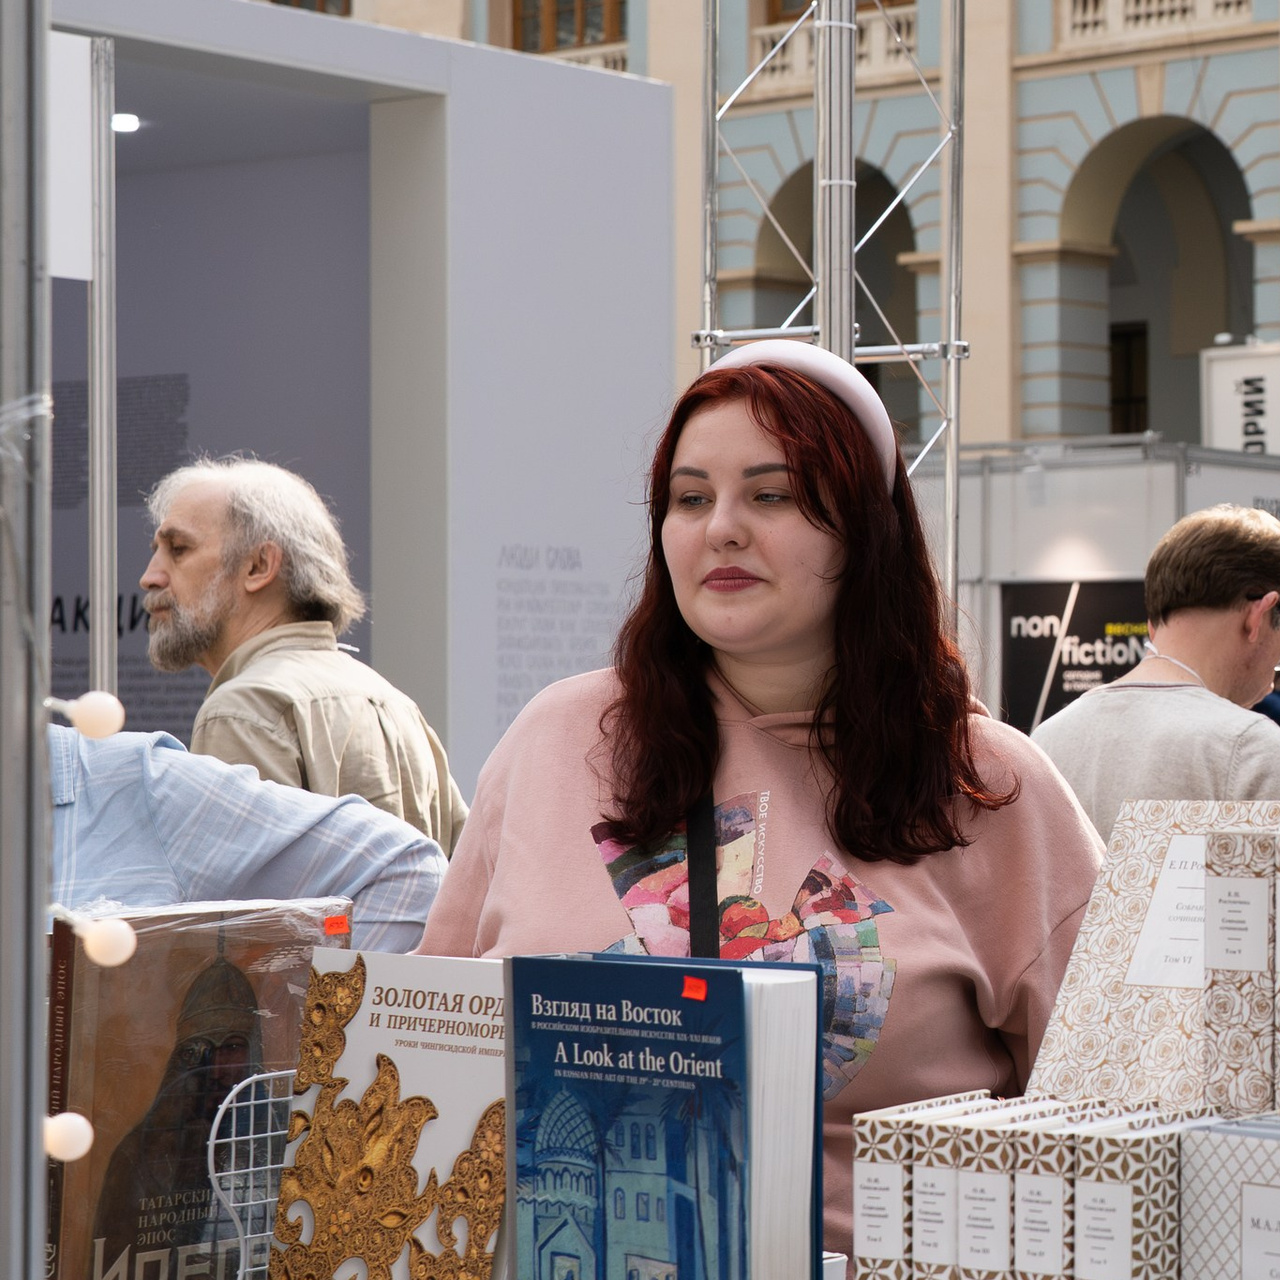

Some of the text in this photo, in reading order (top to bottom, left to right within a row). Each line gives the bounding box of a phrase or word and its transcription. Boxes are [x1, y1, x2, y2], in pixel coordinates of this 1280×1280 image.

[1010, 615, 1060, 638] non
[753, 790, 770, 894] ТВОЕ ИСКУССТВО
[372, 986, 465, 1013] ЗОЛОТАЯ
[531, 993, 683, 1027] Взгляд на Восток
[369, 1012, 381, 1027] И
[394, 1038, 418, 1049] УРОКИ
[555, 1041, 723, 1079] A Look at the Orient
[136, 1229, 176, 1246] ЭПОС
